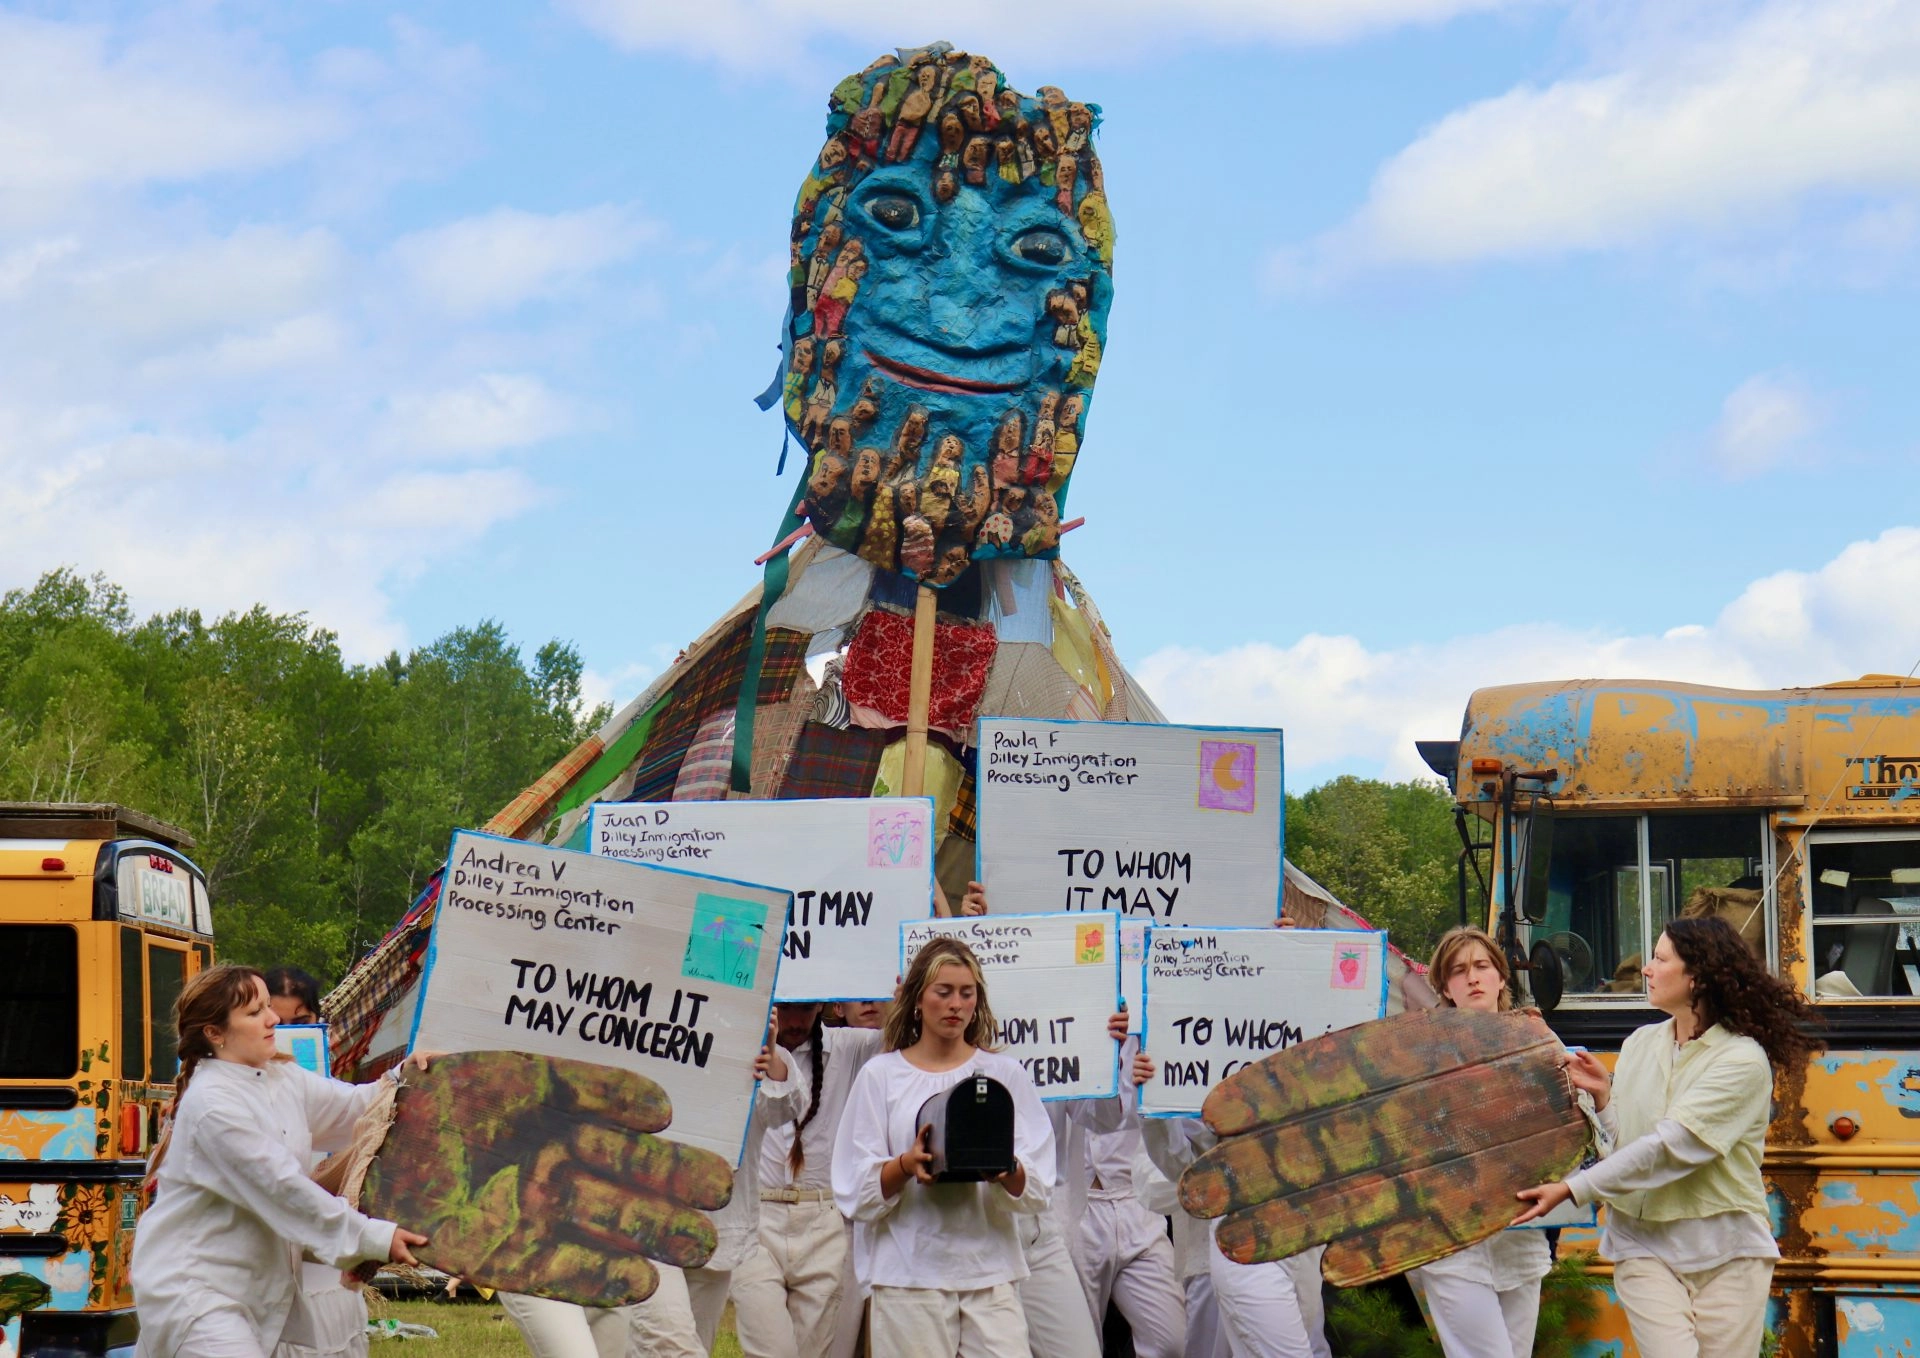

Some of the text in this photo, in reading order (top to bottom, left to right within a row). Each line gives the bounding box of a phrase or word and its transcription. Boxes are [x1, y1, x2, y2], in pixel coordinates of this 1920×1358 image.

[994, 730, 1060, 750] Paula F
[990, 752, 1137, 772] Dilley Inmigration
[1846, 755, 1920, 784] Tho
[987, 769, 1140, 793] Processing Center
[601, 810, 669, 828] Juan D
[601, 828, 726, 847] Dilley Inmigration
[460, 847, 540, 880] Andrea
[602, 845, 713, 862] Processing Center
[1057, 848, 1192, 884] TO WHOM
[142, 871, 187, 925] BREAD
[454, 870, 634, 914] Dilley Inmigration
[1066, 886, 1179, 917] IT MAY
[448, 890, 621, 935] Processing Center
[788, 890, 874, 927] IT MAY
[971, 923, 1033, 939] Guerra
[1154, 936, 1188, 955] Gaby
[976, 953, 1021, 966] enter
[1153, 963, 1265, 981] Processing Center
[510, 959, 710, 1029] TO WHOM IT
[504, 994, 715, 1069] MAY CONCERN
[994, 1016, 1076, 1045] HOM IT
[1172, 1016, 1304, 1051] TO WHOM
[1164, 1058, 1210, 1087] MAY
